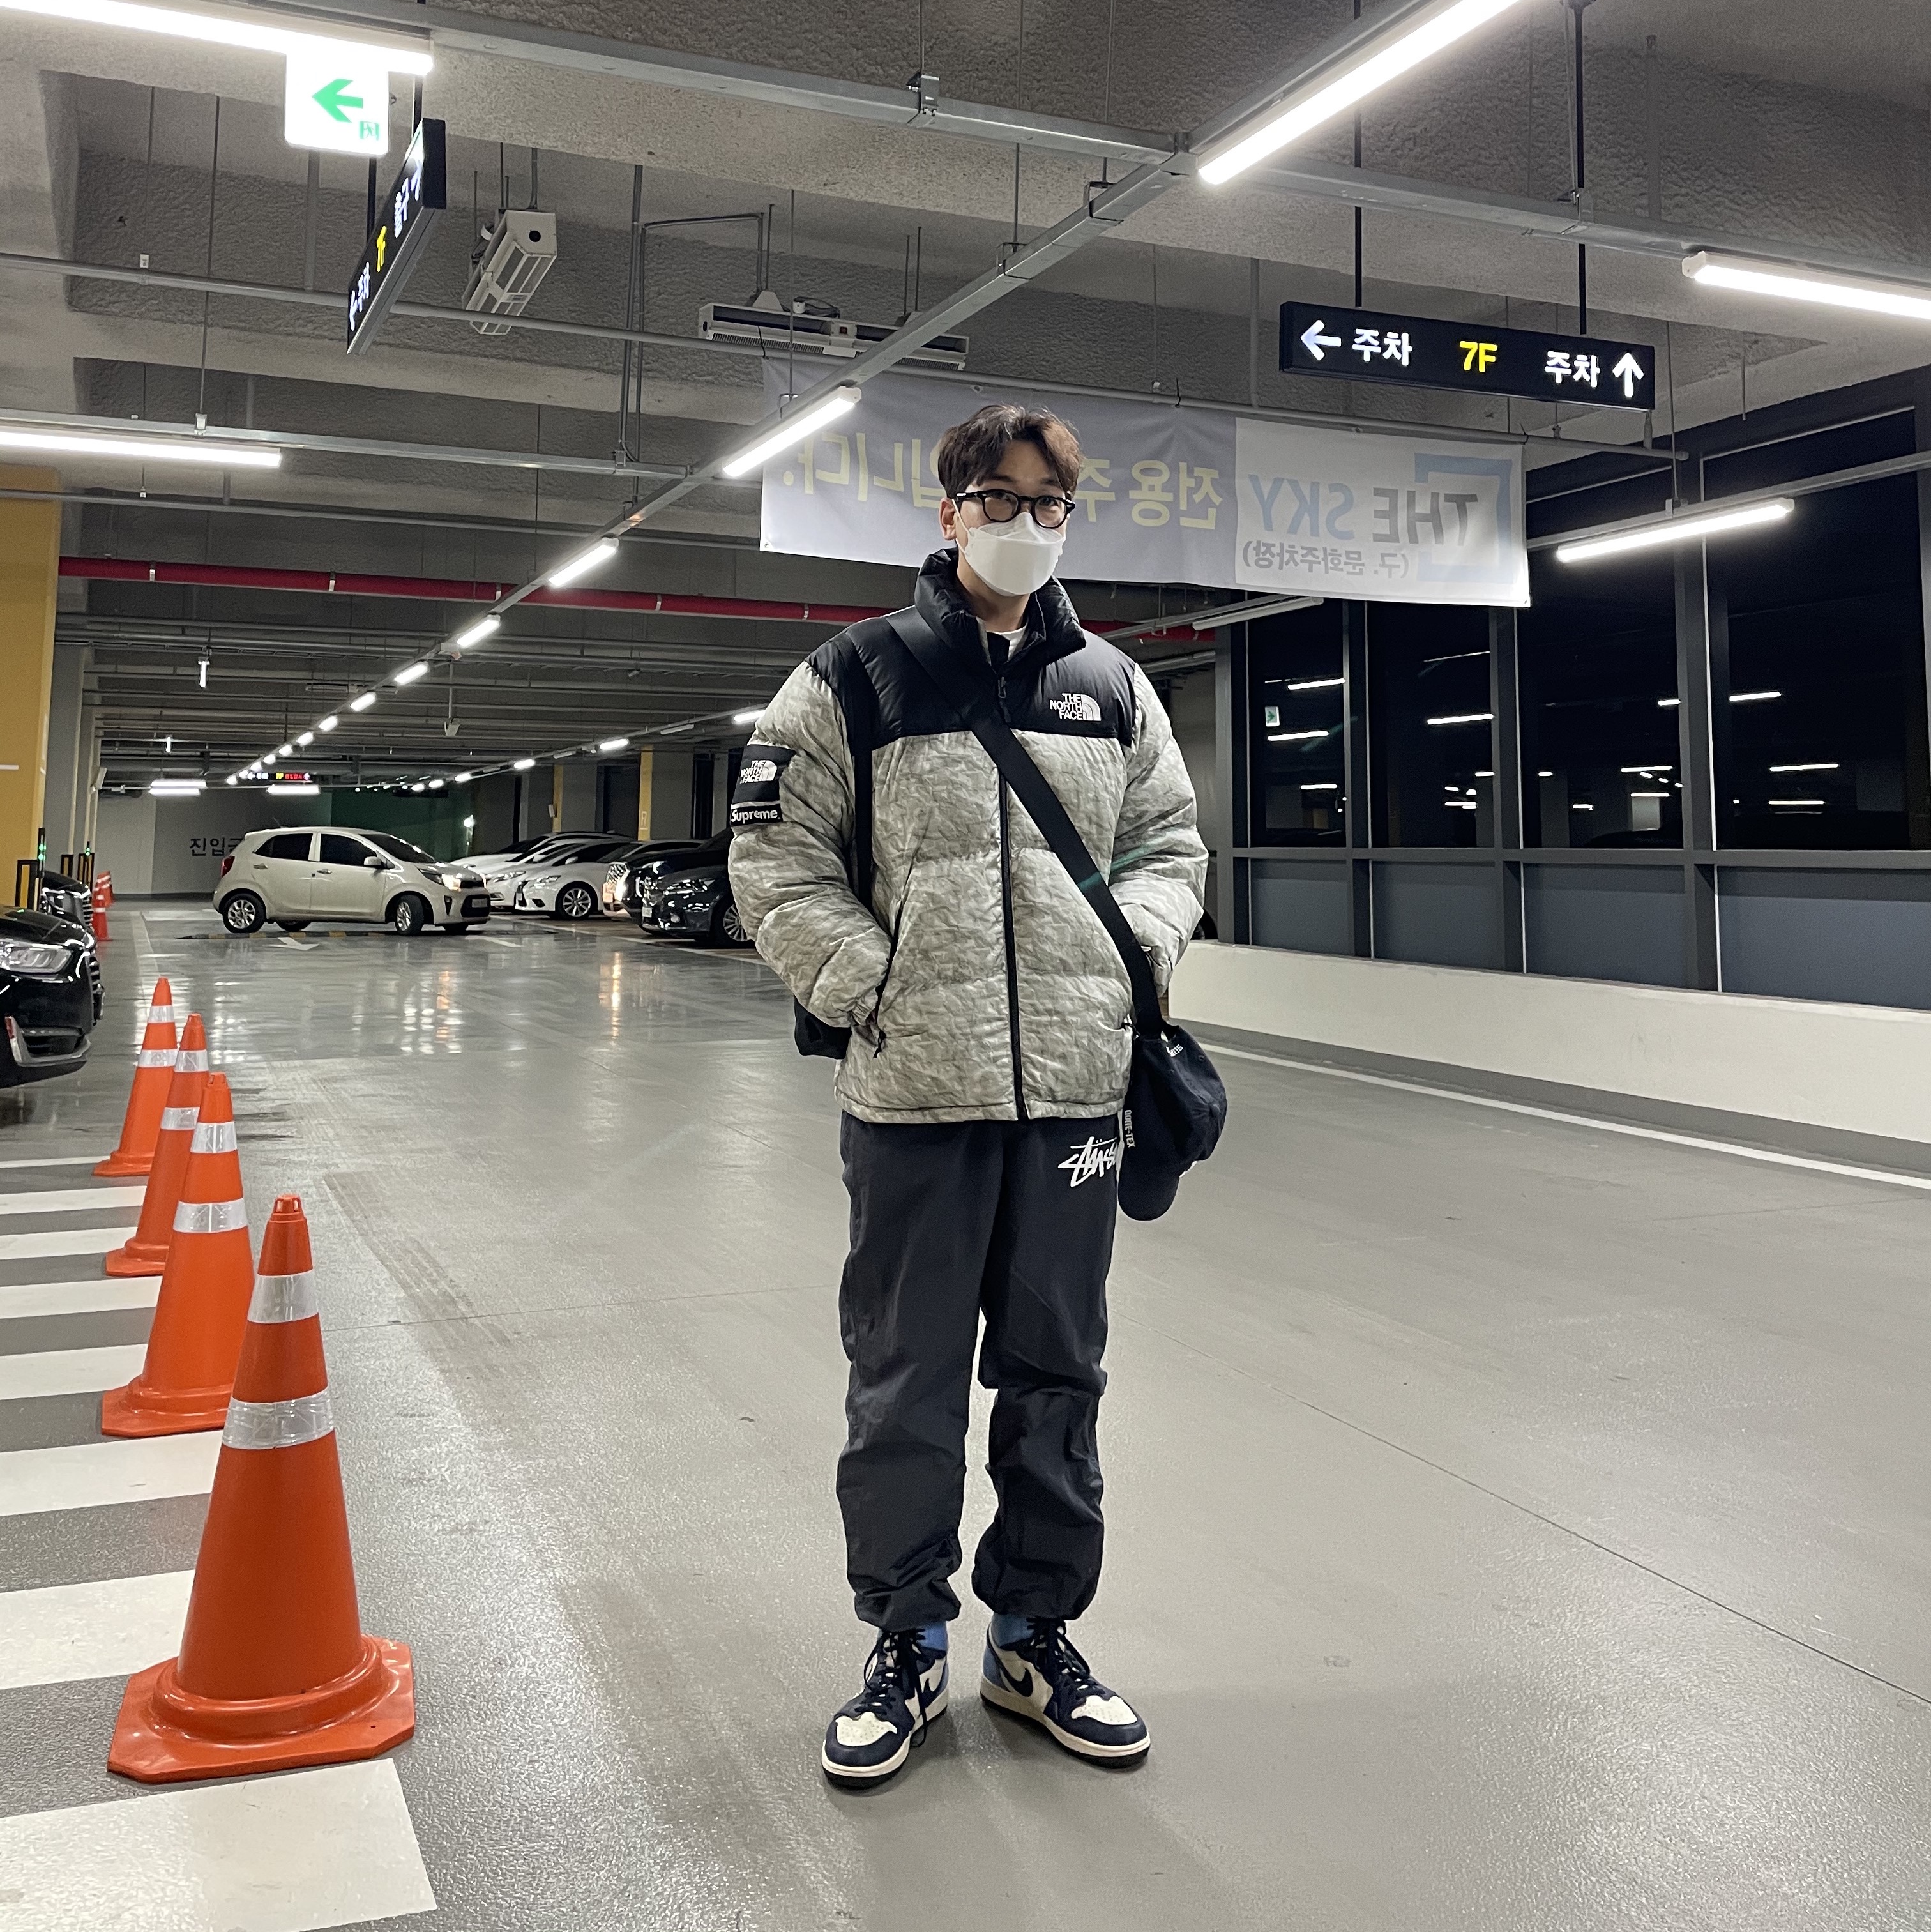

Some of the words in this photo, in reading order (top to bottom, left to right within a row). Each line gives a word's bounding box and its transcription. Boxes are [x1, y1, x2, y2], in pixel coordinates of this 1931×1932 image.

[1352, 328, 1412, 367] 주차
[1460, 340, 1498, 373] 7F
[1545, 351, 1601, 388] 주차
[1061, 693, 1082, 703] THE
[1049, 699, 1082, 713] NORTH
[1059, 710, 1084, 720] FACE
[740, 766, 762, 778] NORTH
[741, 774, 761, 784] FACE
[731, 809, 778, 824] Supreme
